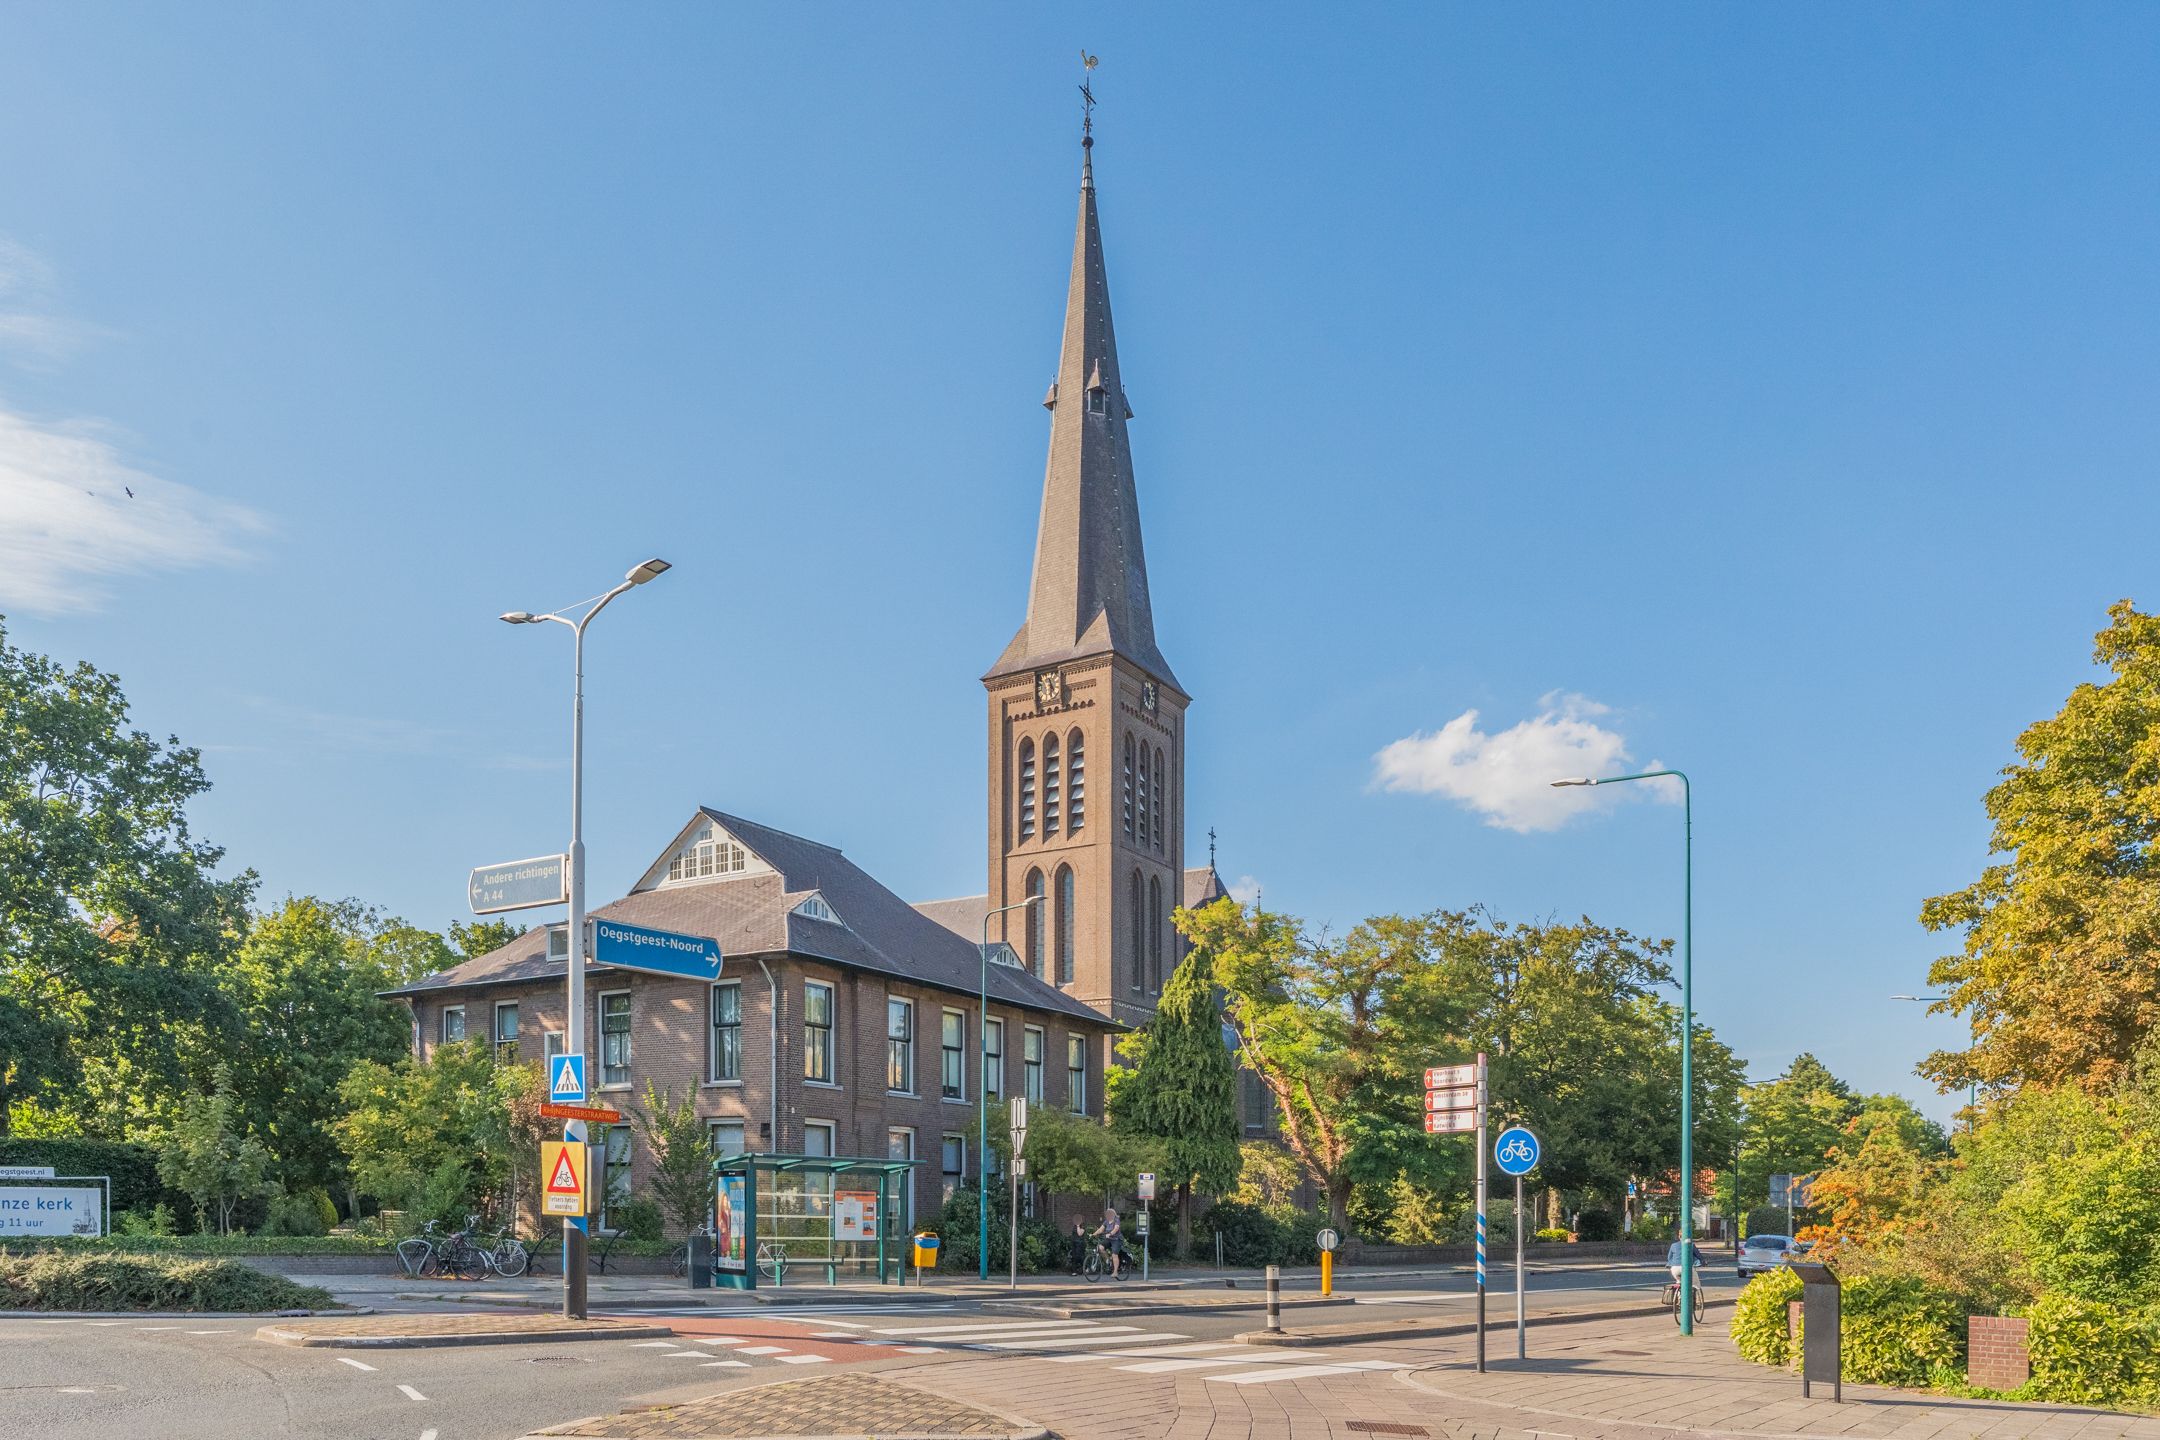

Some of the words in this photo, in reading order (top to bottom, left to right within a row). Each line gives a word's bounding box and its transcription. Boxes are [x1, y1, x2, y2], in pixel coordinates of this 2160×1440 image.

[484, 872, 513, 885] Andere
[515, 865, 559, 880] richtingen
[483, 891, 490, 902] A
[492, 889, 503, 900] 44
[600, 925, 703, 953] Oegstgeest-Noord
[2, 1199, 30, 1209] nze
[37, 1196, 73, 1210] kerk
[9, 1218, 22, 1227] 11
